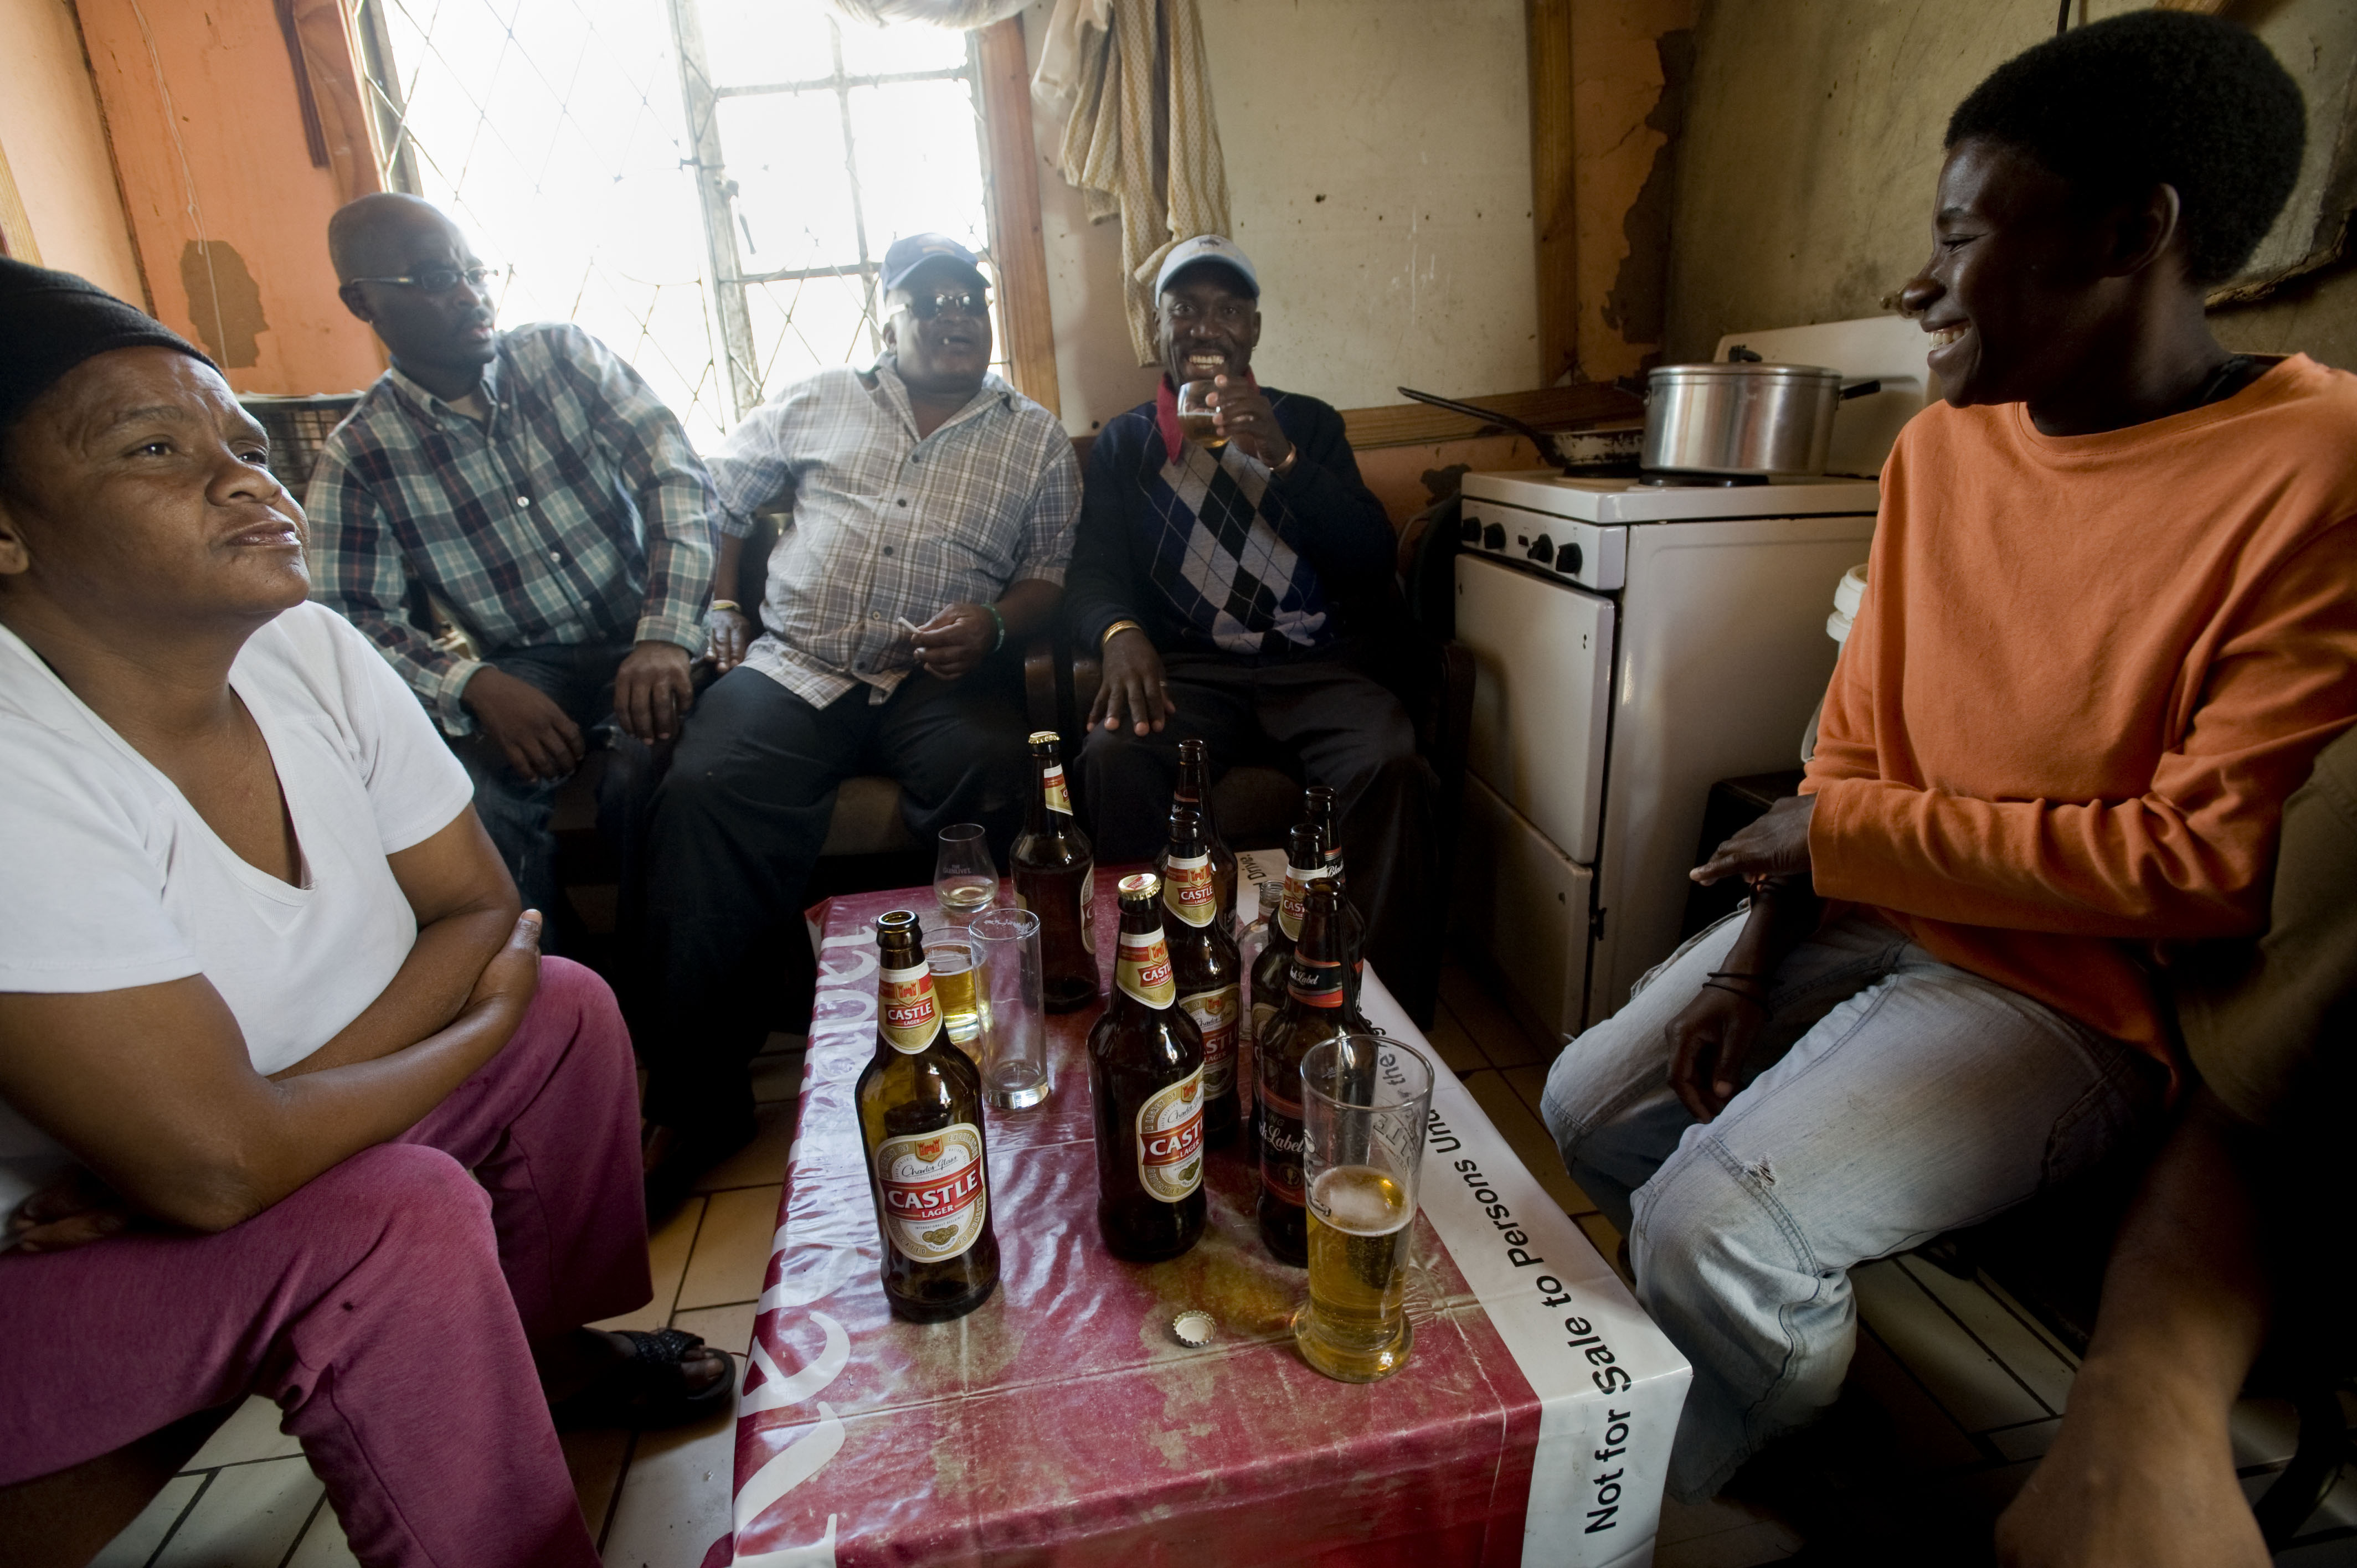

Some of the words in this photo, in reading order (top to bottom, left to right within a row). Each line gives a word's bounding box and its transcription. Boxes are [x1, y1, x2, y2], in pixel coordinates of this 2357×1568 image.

[1240, 854, 1267, 880] Drive.
[1181, 885, 1213, 900] CASTLE
[1284, 900, 1305, 912] CAST
[1143, 962, 1171, 982] CASTL
[1297, 972, 1319, 986] Label
[888, 1002, 932, 1020] CASTLE
[1205, 1051, 1227, 1062] LAGER
[1380, 1051, 1408, 1091] the
[1146, 1100, 1166, 1123] LEGACY
[1168, 1091, 1177, 1100] OF
[898, 1144, 909, 1152] OF
[1180, 1139, 1200, 1158] LAGER
[1267, 1125, 1304, 1153] Label
[888, 1169, 977, 1209] CASTLE
[1147, 1169, 1180, 1194] DEDICATED
[922, 1205, 954, 1219] LAGER
[1454, 1158, 1544, 1268] Persons
[958, 1235, 967, 1245] TO
[1536, 1275, 1572, 1309] to
[1567, 1314, 1632, 1394] Sale
[1595, 1409, 1630, 1462] for
[1584, 1467, 1624, 1534] Not
